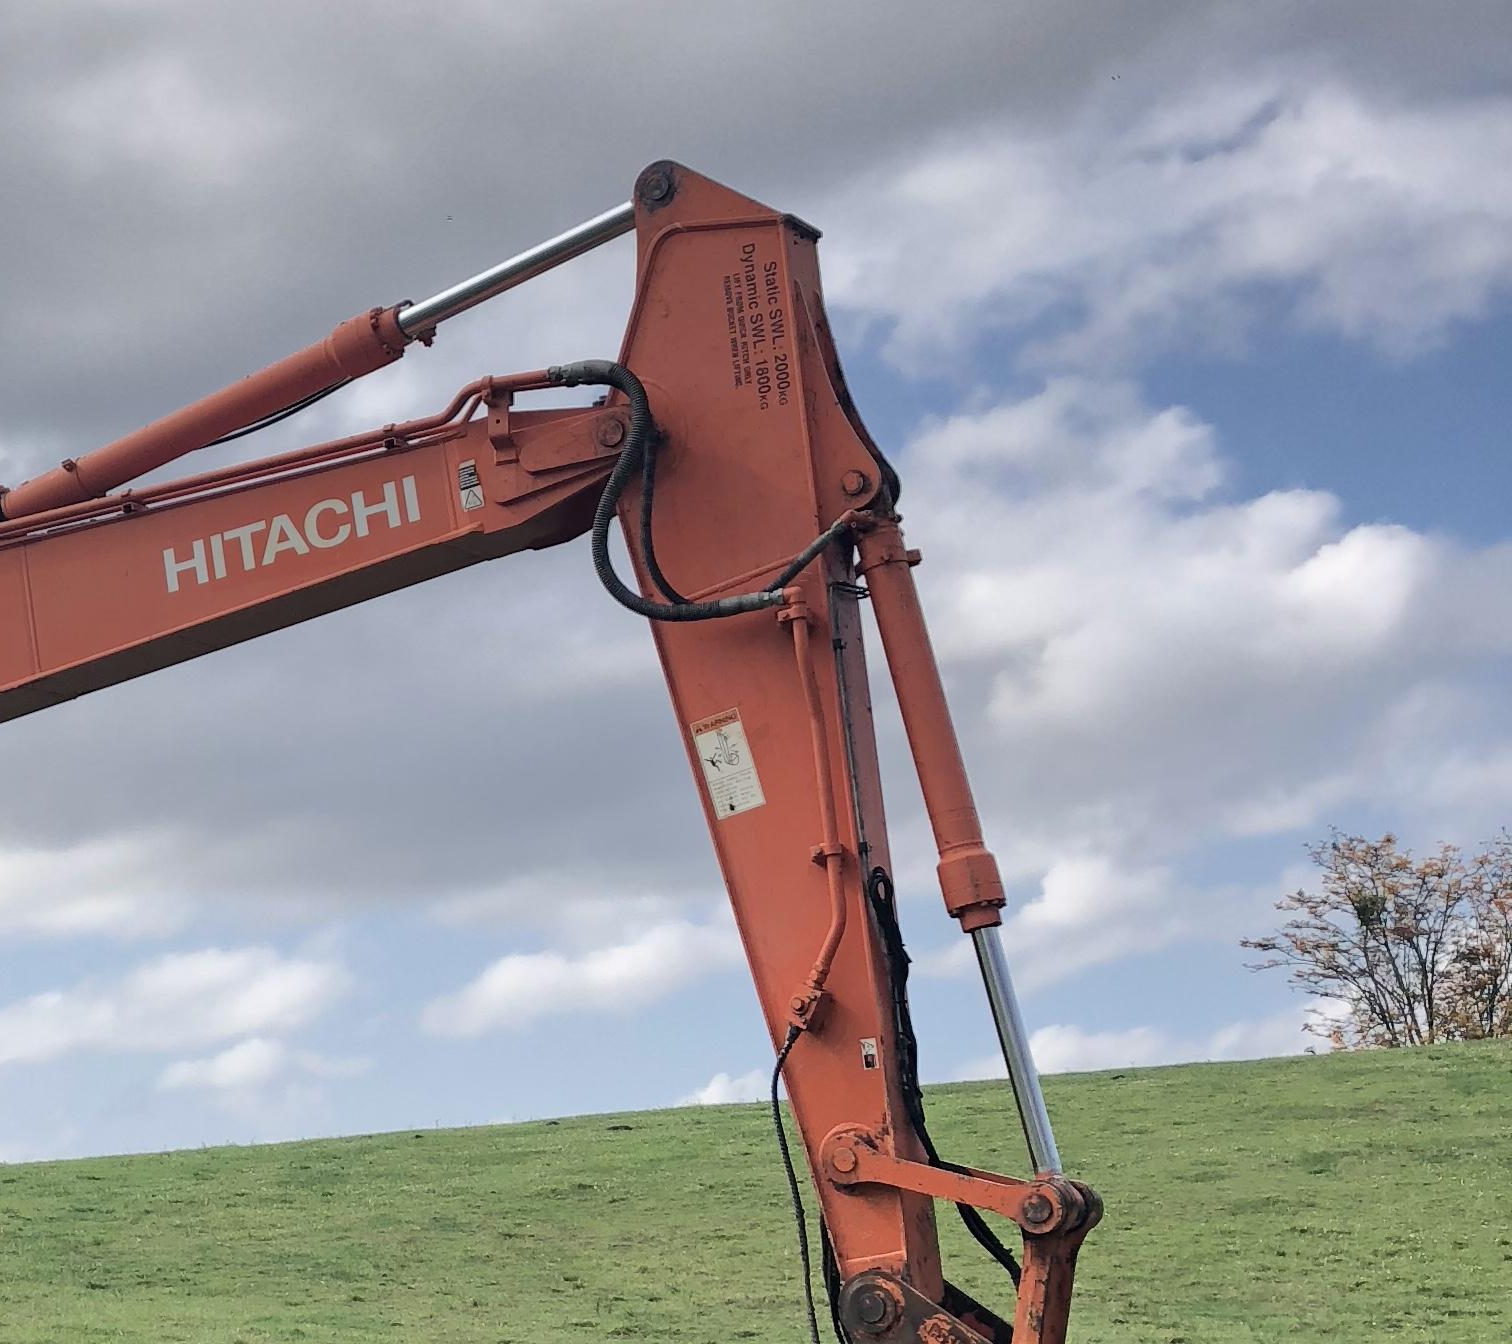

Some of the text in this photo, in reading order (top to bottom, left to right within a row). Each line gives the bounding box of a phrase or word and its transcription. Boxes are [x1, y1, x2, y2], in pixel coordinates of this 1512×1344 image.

[740, 243, 759, 310] Dynamic
[750, 313, 766, 355] SWL:
[764, 261, 780, 305] Static
[769, 309, 785, 350] SWL:
[163, 474, 421, 593] HITACHI
